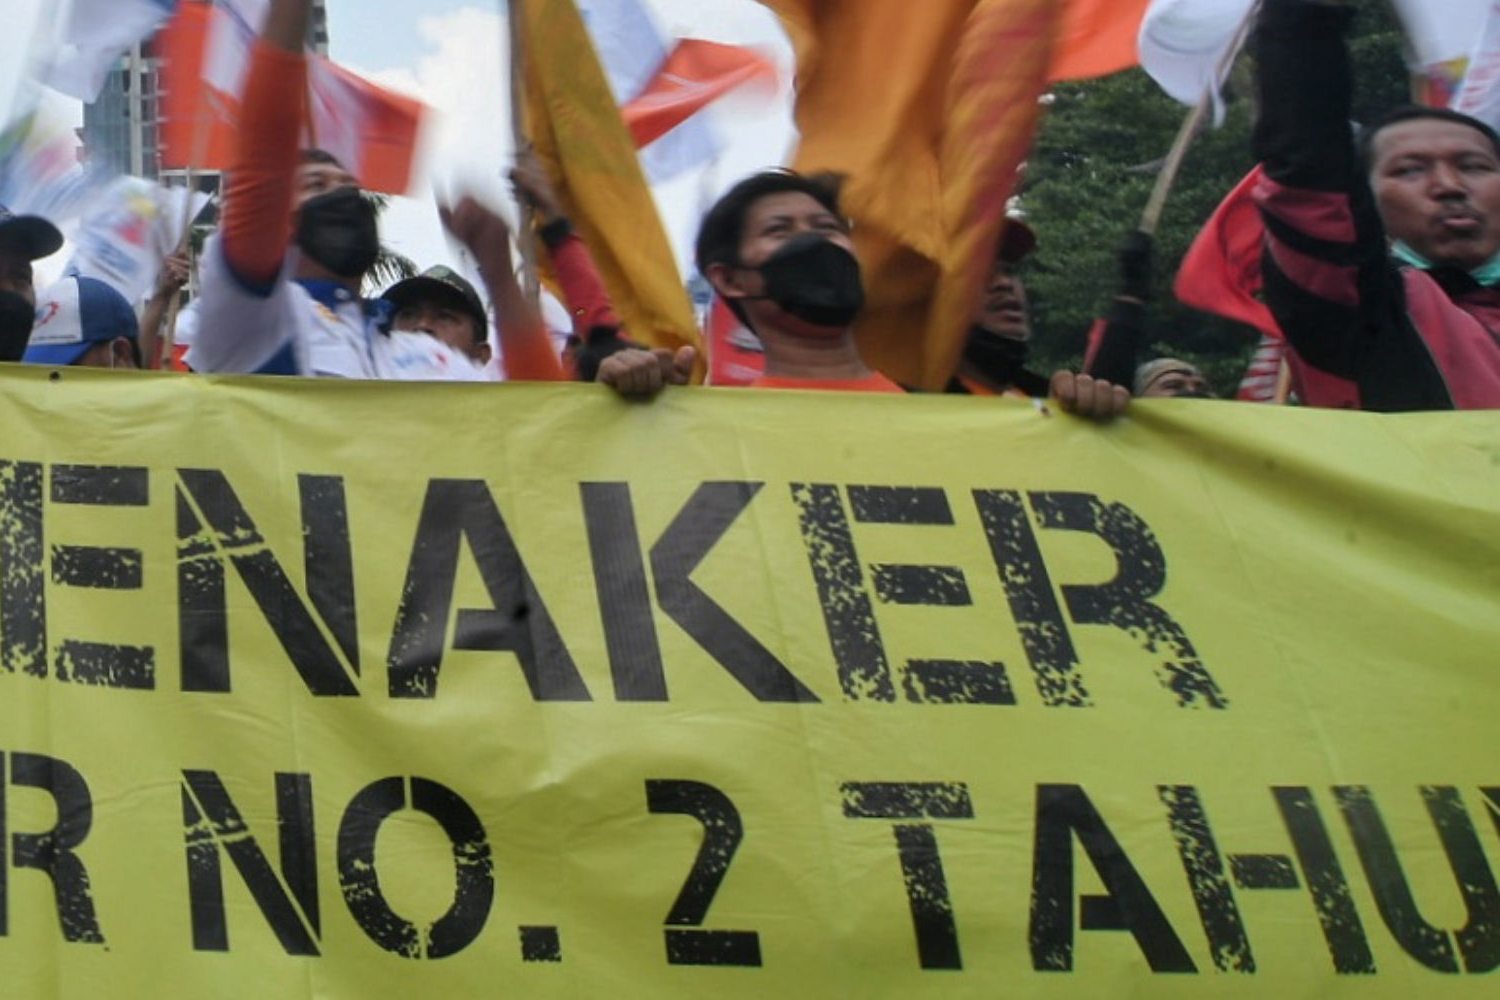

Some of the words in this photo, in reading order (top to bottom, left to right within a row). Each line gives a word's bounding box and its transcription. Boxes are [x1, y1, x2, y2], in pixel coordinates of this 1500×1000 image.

[181, 768, 562, 962] NO.
[645, 778, 763, 967] 2
[837, 781, 1500, 975] TAHU
